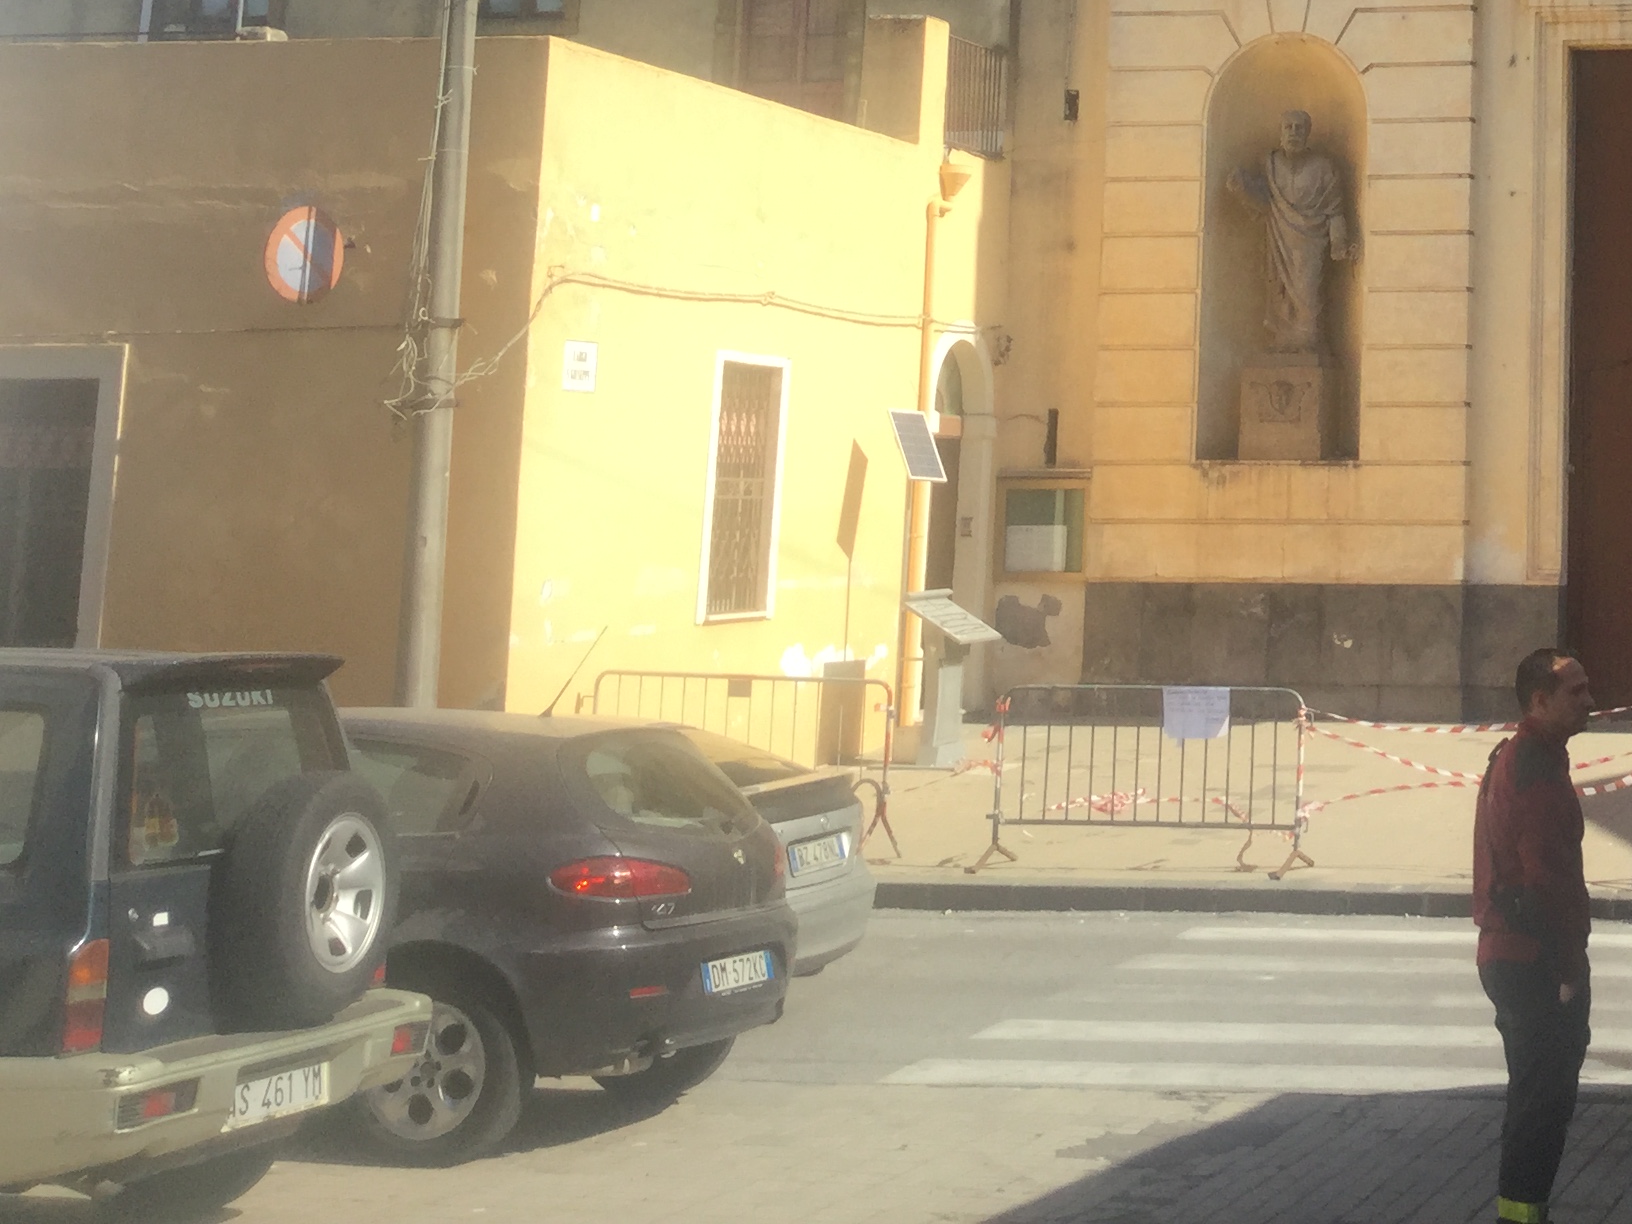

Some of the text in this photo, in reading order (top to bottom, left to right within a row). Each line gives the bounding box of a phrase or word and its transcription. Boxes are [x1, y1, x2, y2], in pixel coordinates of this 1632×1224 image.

[186, 688, 274, 708] SUZUKI
[261, 1072, 293, 1110] 461
[302, 1064, 322, 1098] YM
